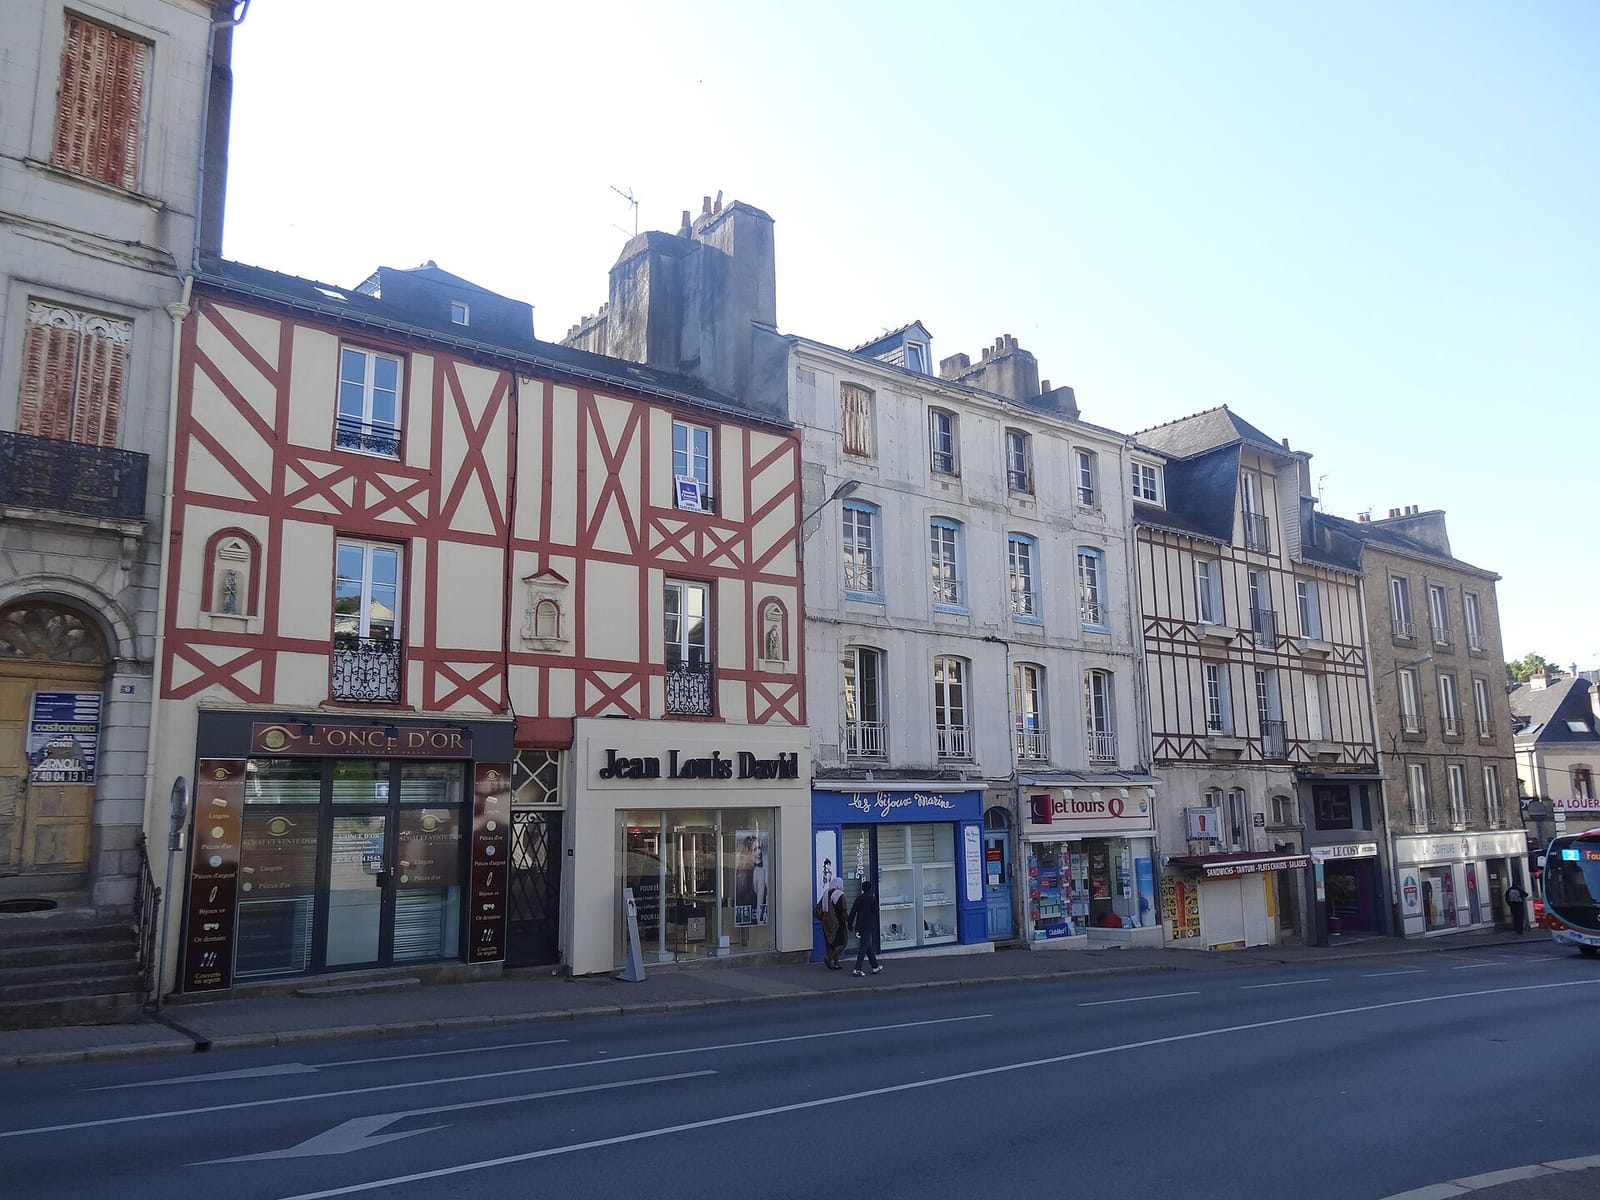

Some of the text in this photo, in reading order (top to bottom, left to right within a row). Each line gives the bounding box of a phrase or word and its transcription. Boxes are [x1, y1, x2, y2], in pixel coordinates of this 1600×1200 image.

[35, 723, 96, 732] castorama
[308, 727, 465, 749] L'ONCE D'OR
[599, 748, 800, 780] Jean Louis David
[874, 791, 912, 818] bijoux
[913, 793, 956, 809] Marine
[1071, 798, 1106, 814] tours
[1567, 799, 1600, 809] LOUER
[1332, 846, 1342, 857] LE
[1342, 845, 1360, 857] COSY
[1206, 866, 1234, 877] SANDWICHS
[1258, 862, 1270, 872] PLATS
